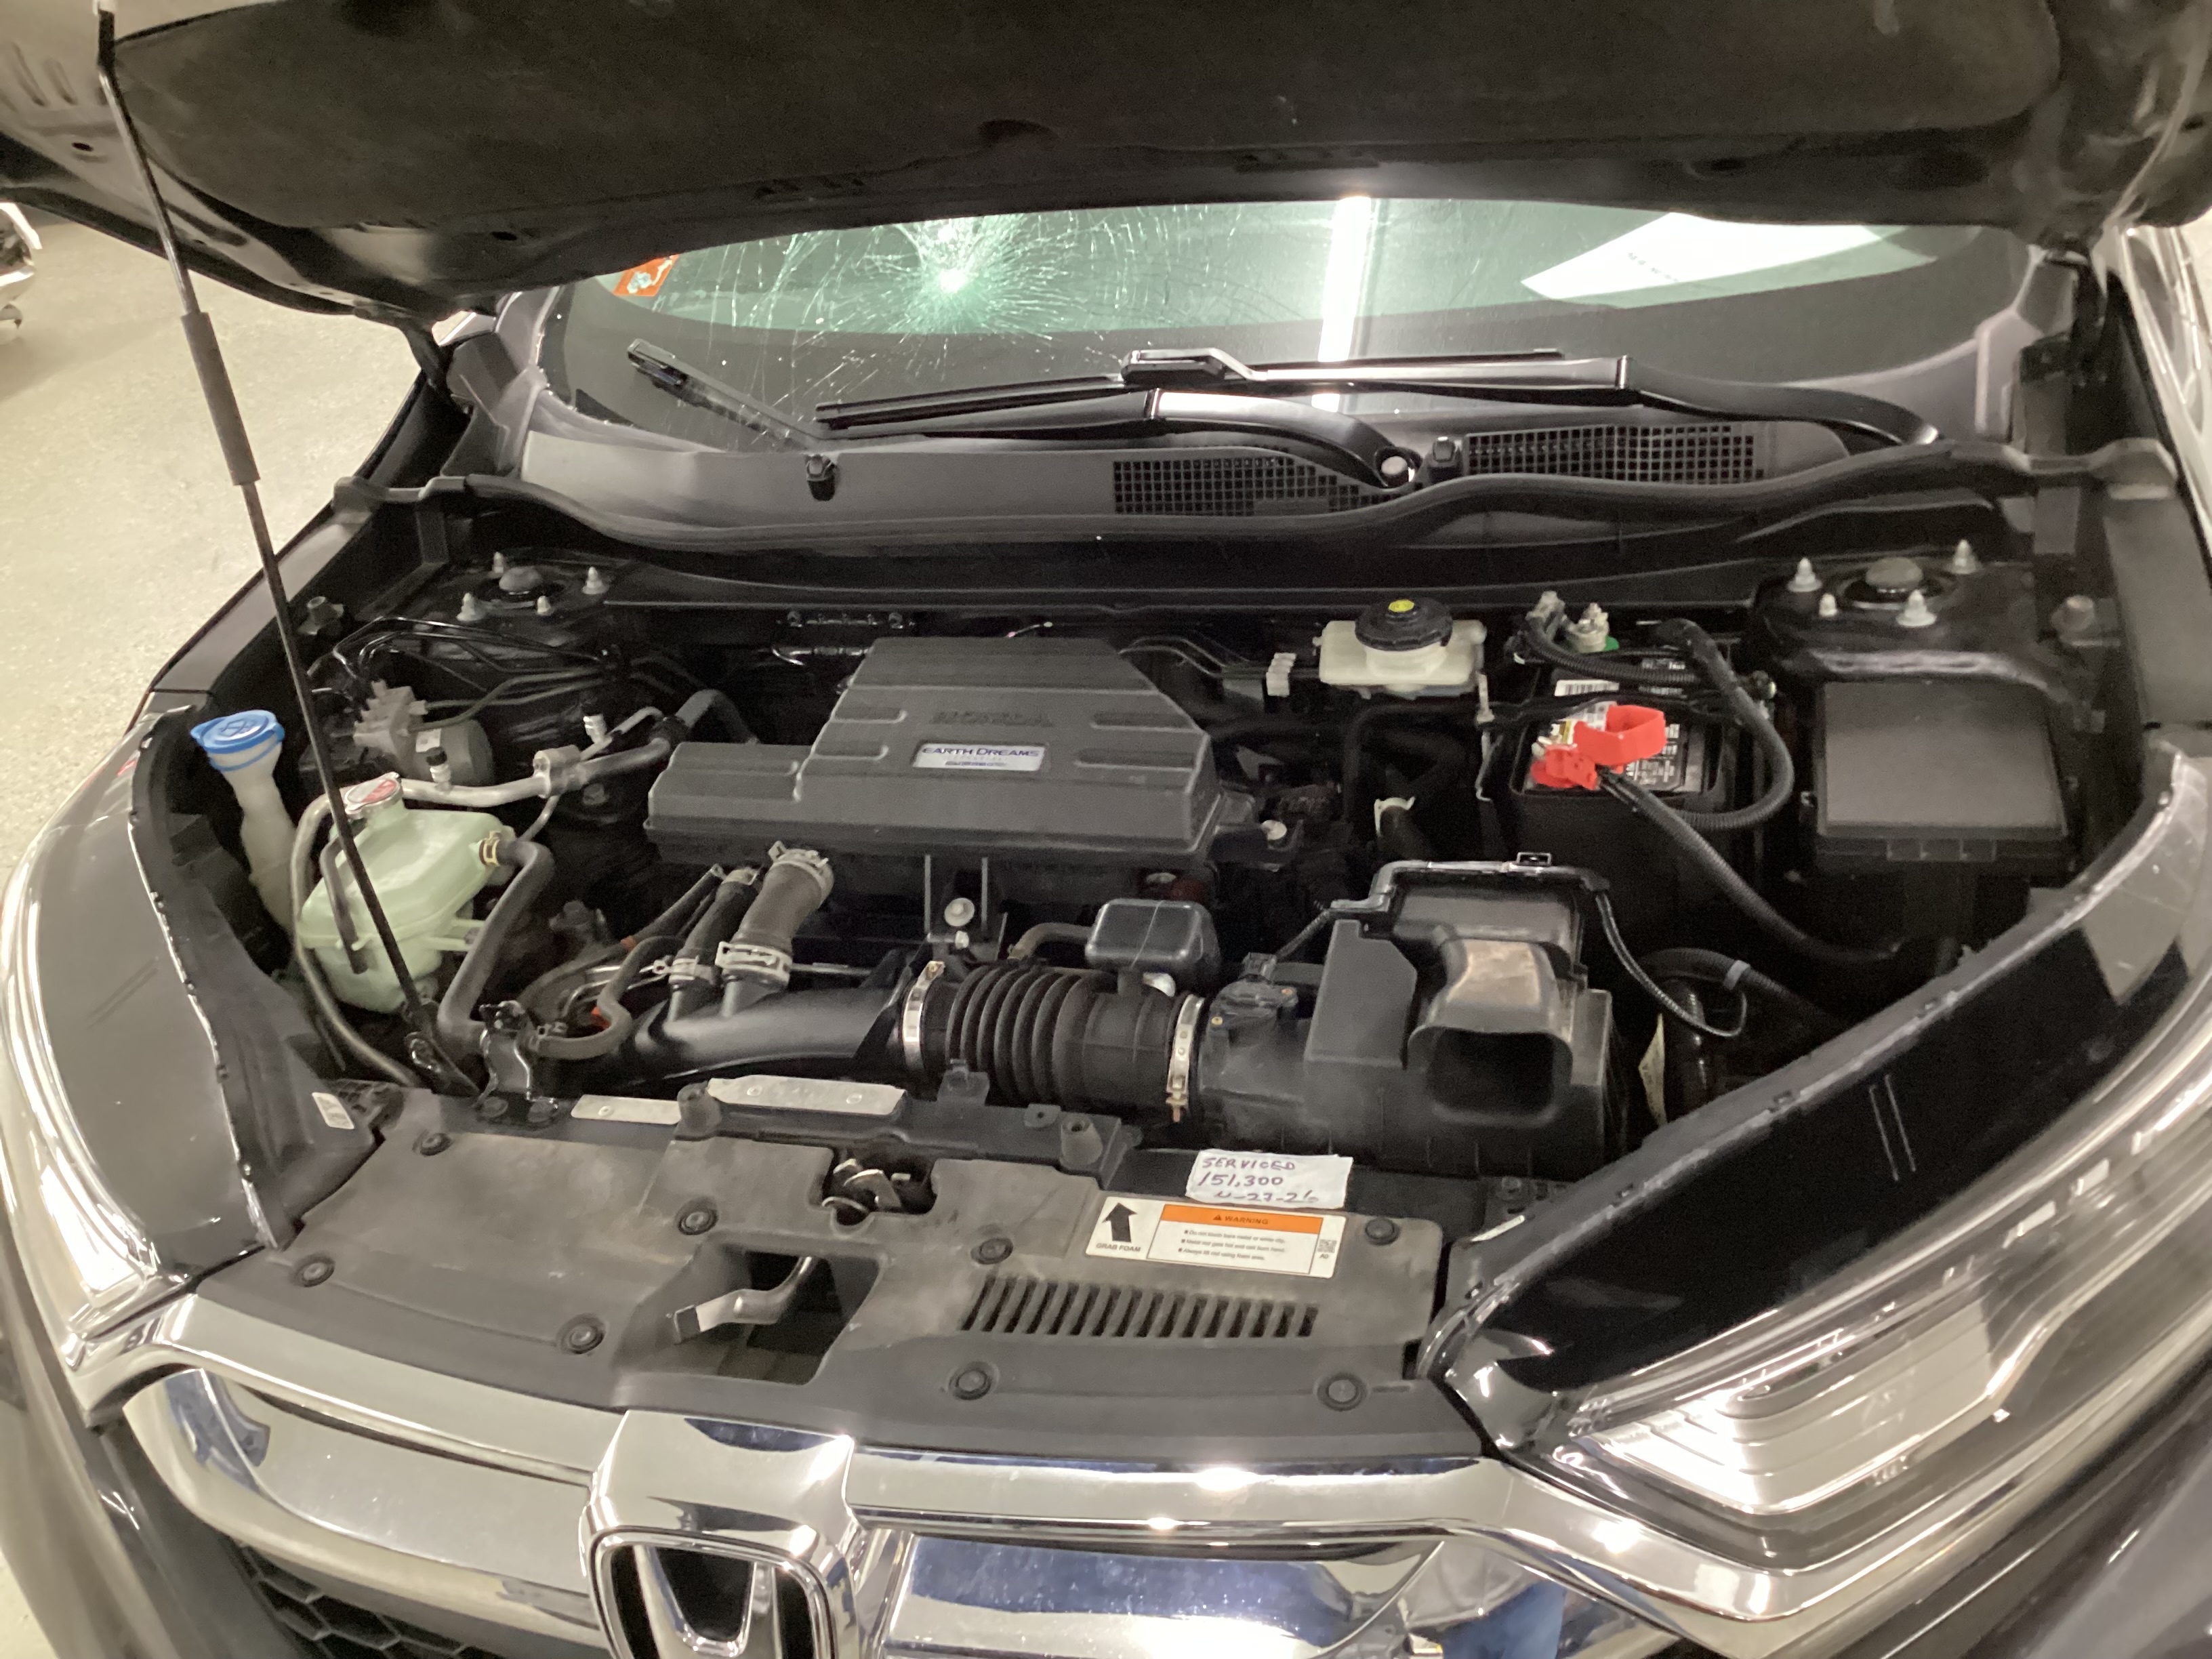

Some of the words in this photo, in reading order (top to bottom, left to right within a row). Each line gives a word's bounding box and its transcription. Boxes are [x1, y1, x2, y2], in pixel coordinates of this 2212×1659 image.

[976, 747, 1040, 757] DREAMS
[1202, 1158, 1295, 1171] SERVICED
[1197, 1171, 1284, 1187] 151,300
[1225, 1215, 1269, 1225] WARNING
